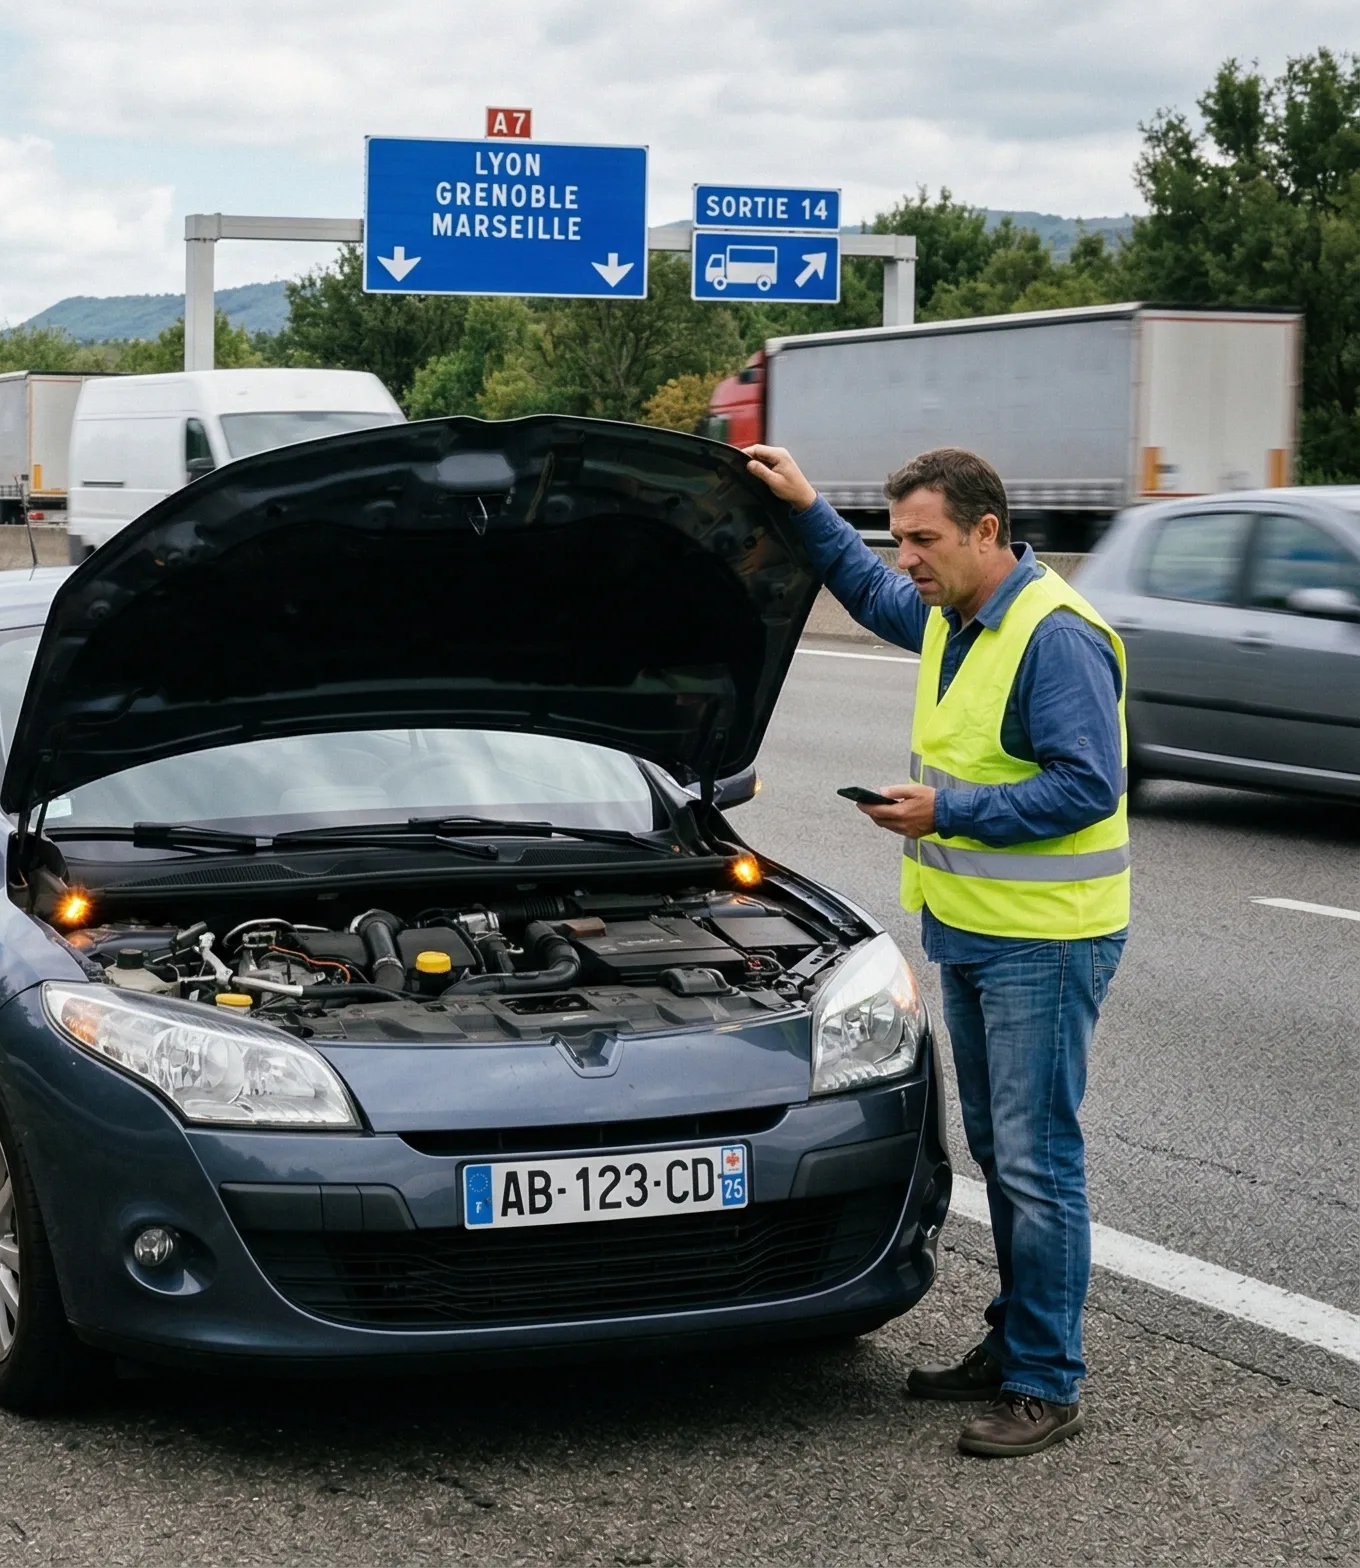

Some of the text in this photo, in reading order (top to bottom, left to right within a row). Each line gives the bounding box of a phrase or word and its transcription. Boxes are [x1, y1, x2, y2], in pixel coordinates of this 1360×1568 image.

[493, 112, 525, 136] A7
[475, 151, 540, 177] LYON
[436, 181, 578, 210] GRENOBLE
[705, 195, 828, 221] SORTIE 14
[432, 212, 582, 241] MARSEILLE
[500, 1156, 715, 1217] AB-123-CD
[724, 1178, 743, 1199] 25
[475, 1201, 483, 1214] F
